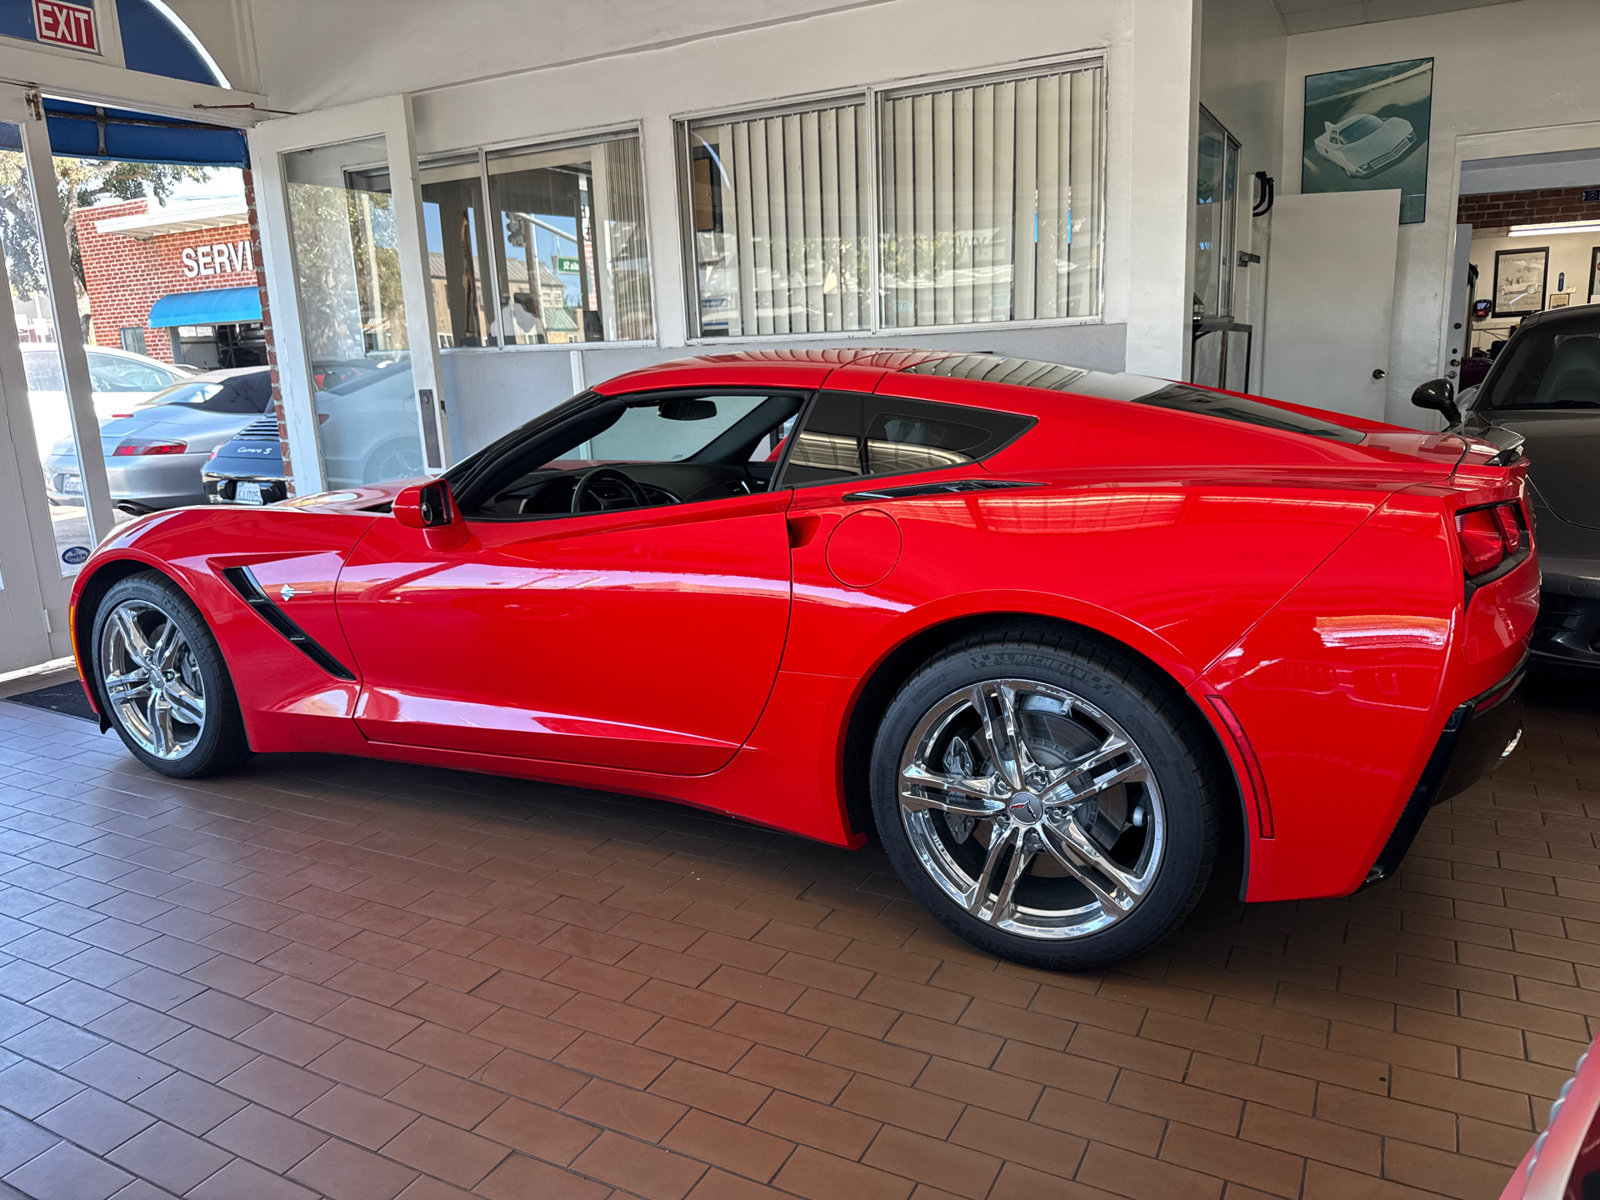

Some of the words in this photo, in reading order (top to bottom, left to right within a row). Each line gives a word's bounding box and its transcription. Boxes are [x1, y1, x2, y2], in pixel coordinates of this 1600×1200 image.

[38, 2, 88, 45] EXIT
[182, 240, 254, 278] SERVI
[263, 447, 273, 455] S
[1015, 654, 1087, 681] MICHELIN
